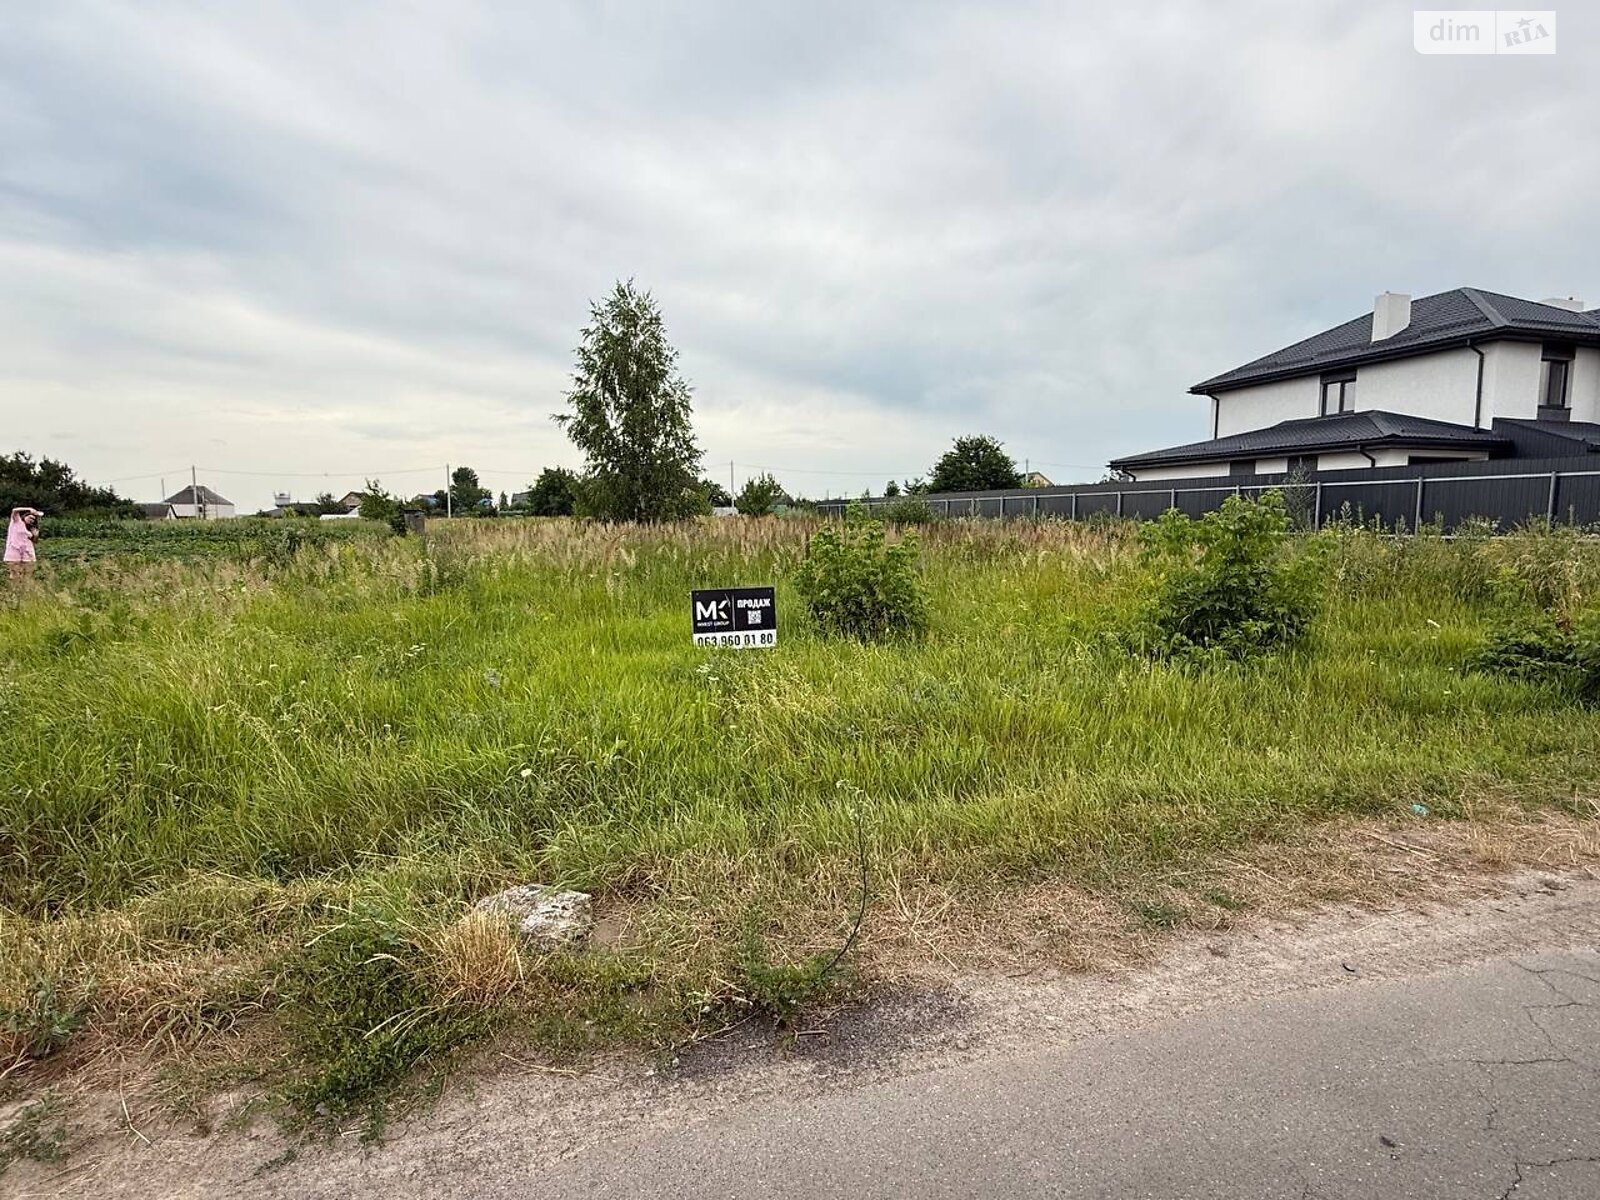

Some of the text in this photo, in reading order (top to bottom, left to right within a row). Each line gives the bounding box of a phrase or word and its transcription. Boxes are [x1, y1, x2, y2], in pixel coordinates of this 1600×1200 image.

[696, 600, 729, 621] MK
[737, 598, 771, 609] ПРОДАЖ
[697, 633, 773, 647] 063 960 01 80
